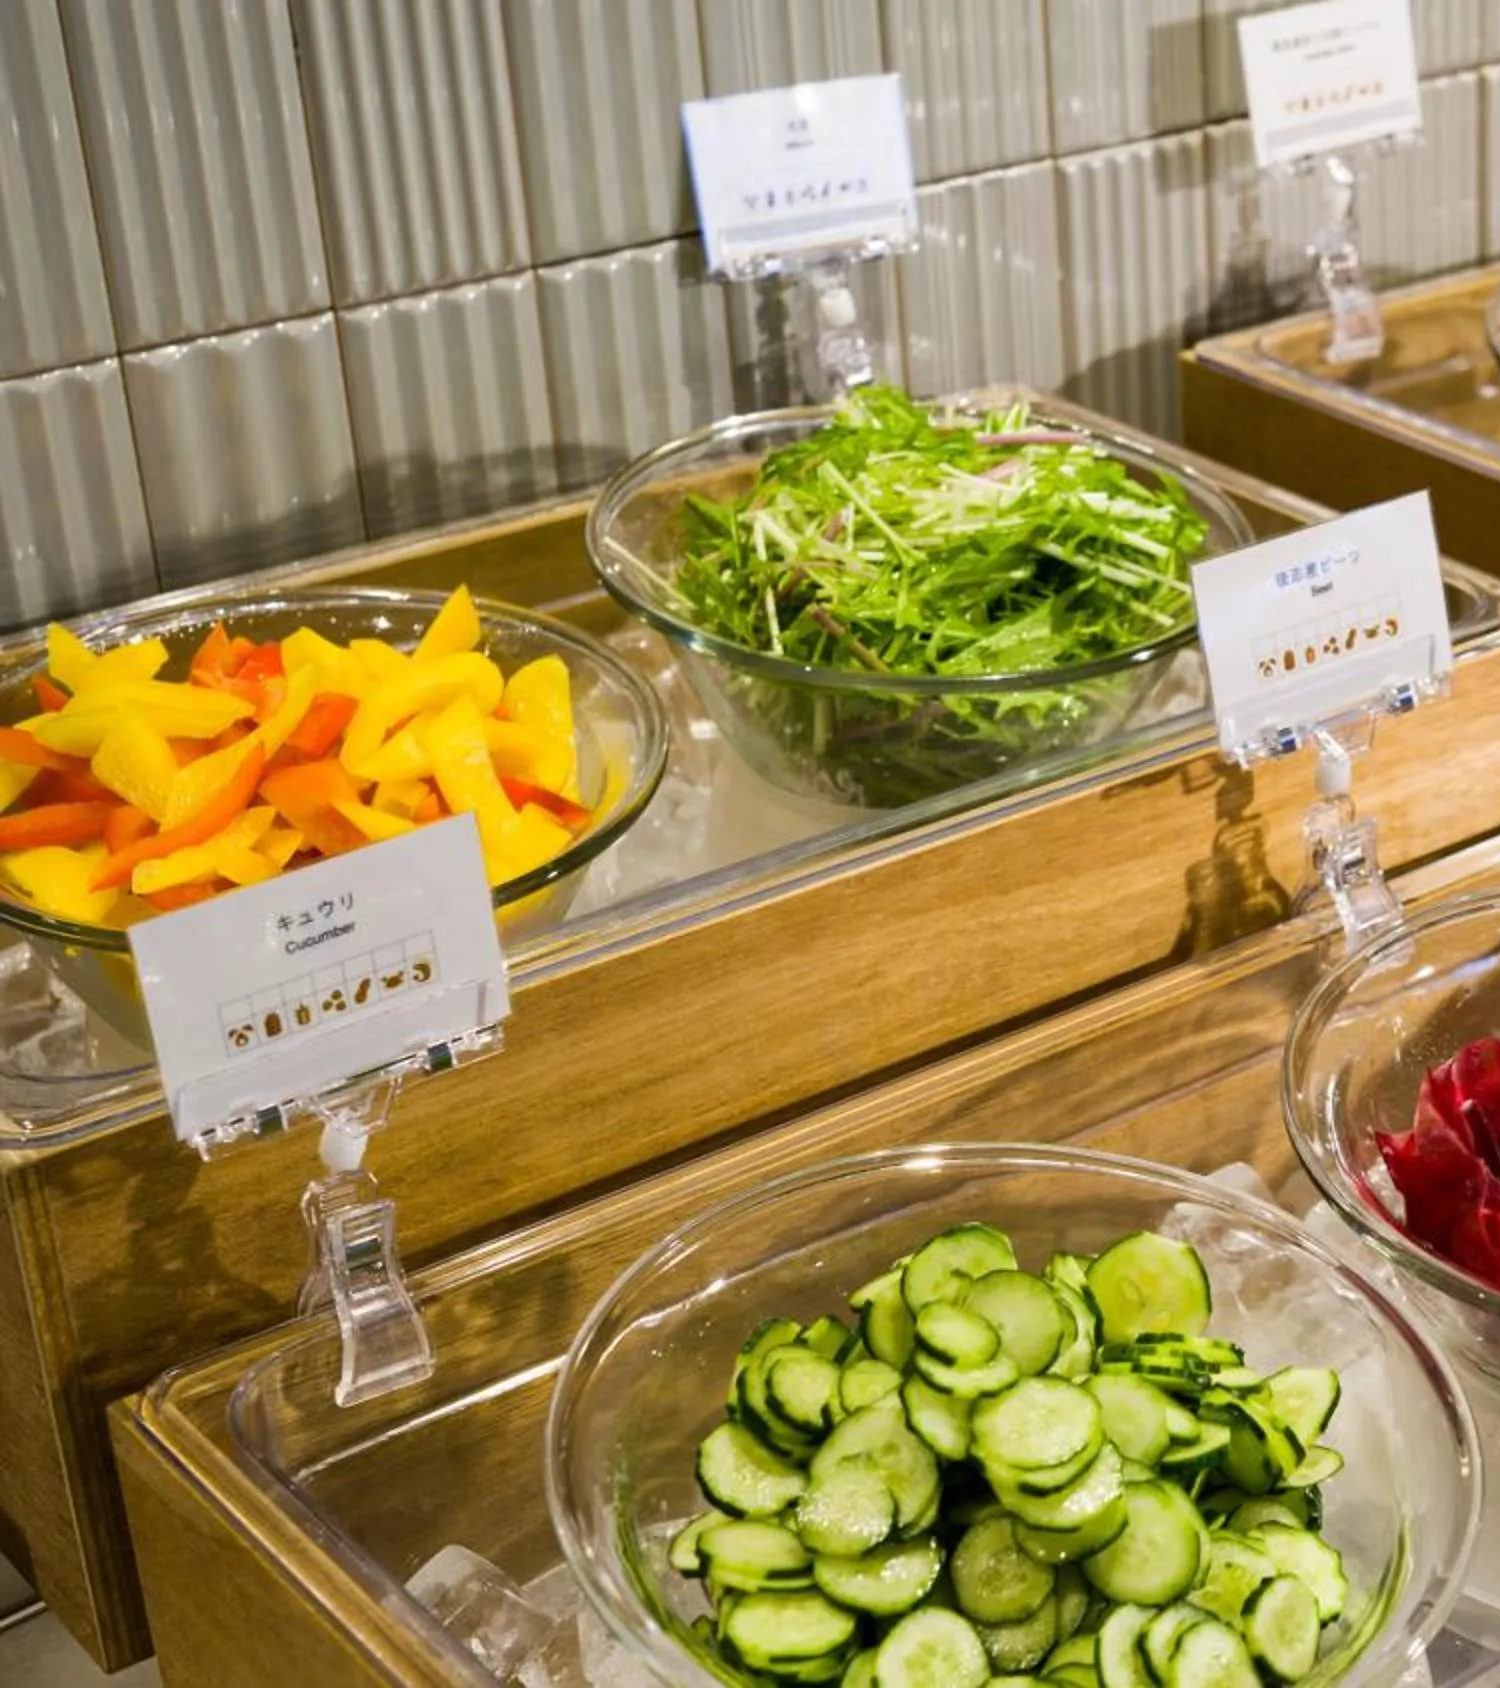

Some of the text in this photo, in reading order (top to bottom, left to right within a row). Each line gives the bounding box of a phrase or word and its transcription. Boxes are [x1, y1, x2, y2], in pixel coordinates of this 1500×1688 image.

[277, 893, 354, 931] キュウリ
[285, 922, 356, 954] Cucumber
